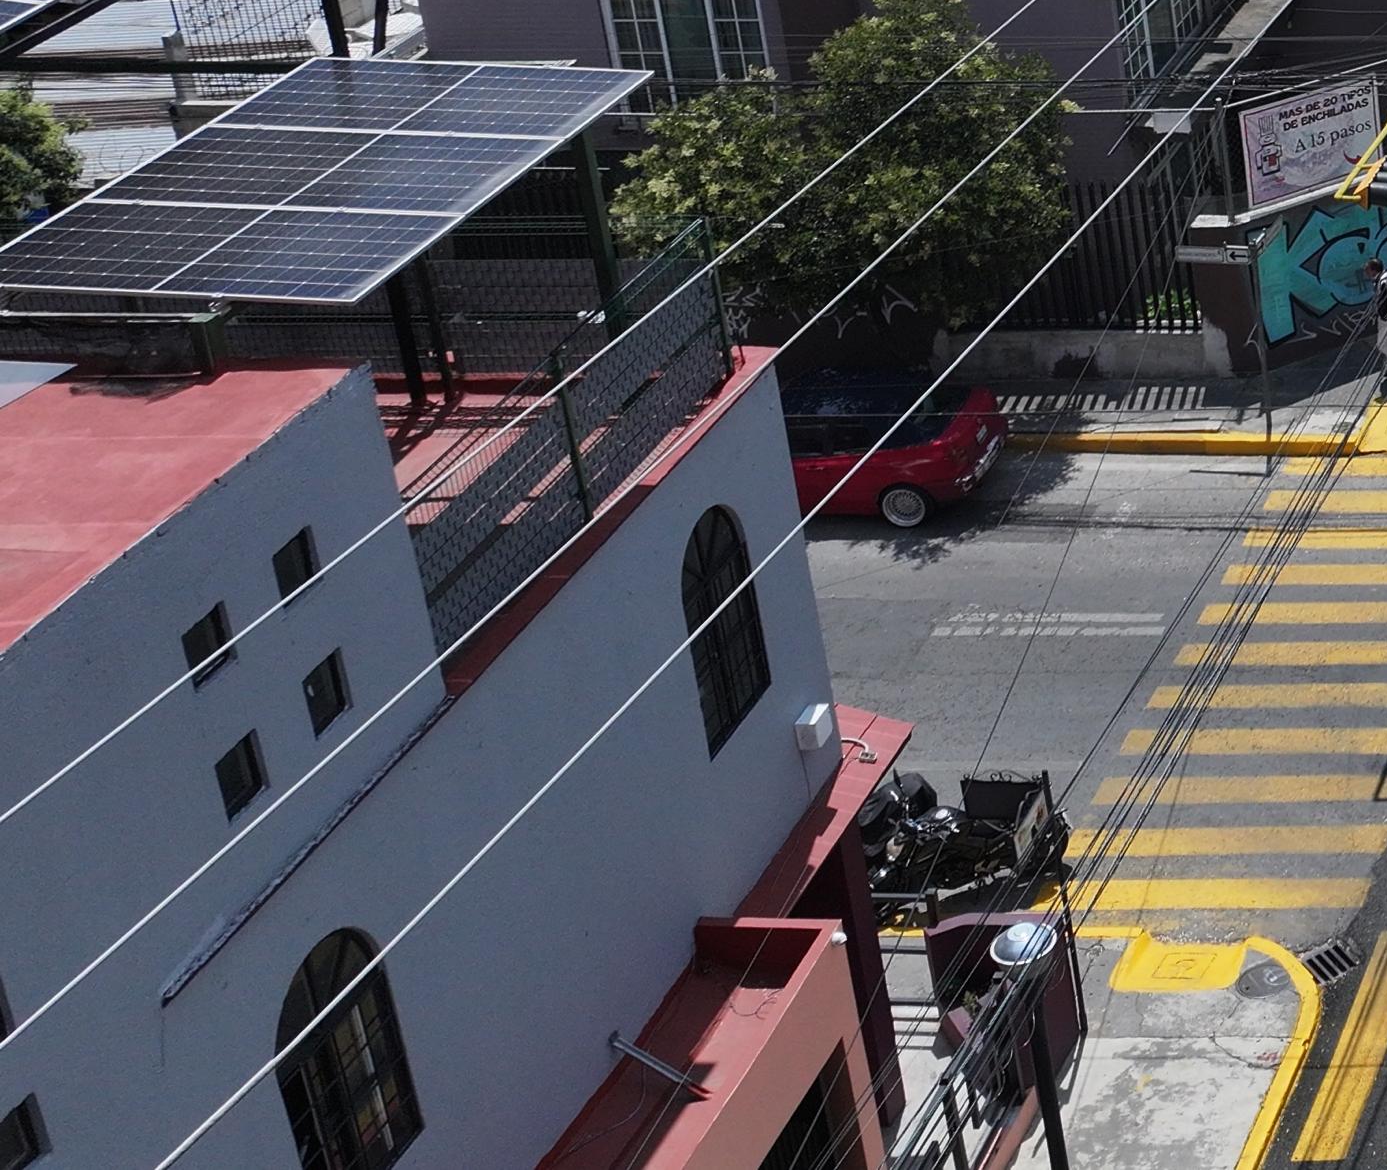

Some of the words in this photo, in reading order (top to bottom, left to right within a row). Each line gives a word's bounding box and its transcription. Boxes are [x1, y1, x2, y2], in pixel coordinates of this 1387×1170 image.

[1279, 106, 1302, 122] MAS
[1305, 101, 1320, 113] DE
[1323, 96, 1338, 108] 20
[1340, 85, 1371, 103] TIPOS
[1283, 119, 1298, 132] DE
[1301, 97, 1369, 127] ENCHILADAS
[1295, 138, 1306, 153] A
[1311, 131, 1325, 148] 15
[1330, 119, 1372, 146] pasos
